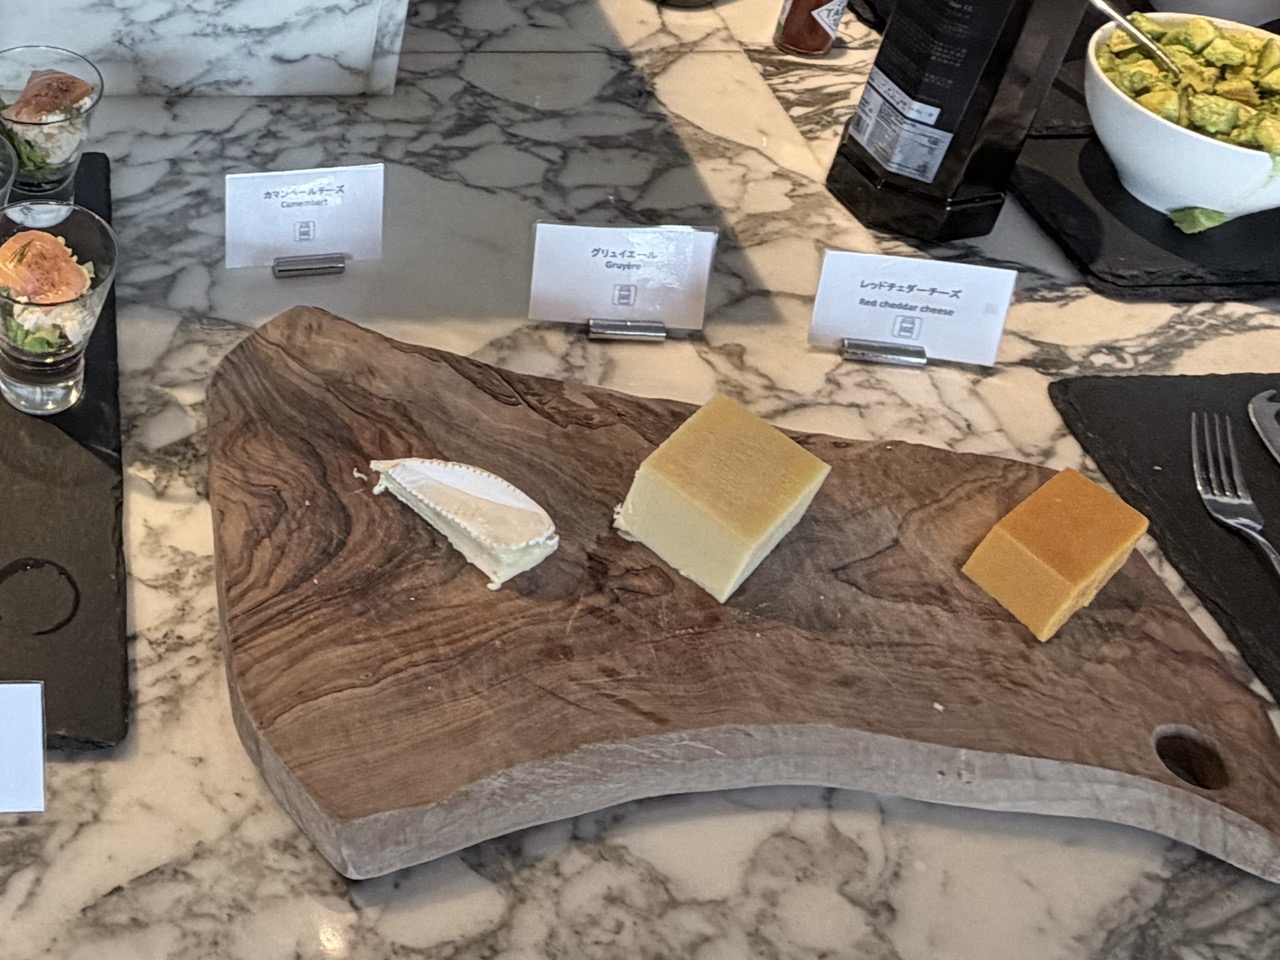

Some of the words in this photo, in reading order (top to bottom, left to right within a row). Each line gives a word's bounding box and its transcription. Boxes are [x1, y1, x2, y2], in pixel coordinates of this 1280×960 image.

[263, 184, 345, 200] カマンベールチーズ
[280, 197, 329, 208] Camembert
[590, 246, 658, 260] グリュイエール
[859, 279, 964, 300] レッドチェダーチーズ
[858, 297, 878, 307] Red
[878, 300, 920, 313] cheddar
[919, 306, 955, 317] cheese
